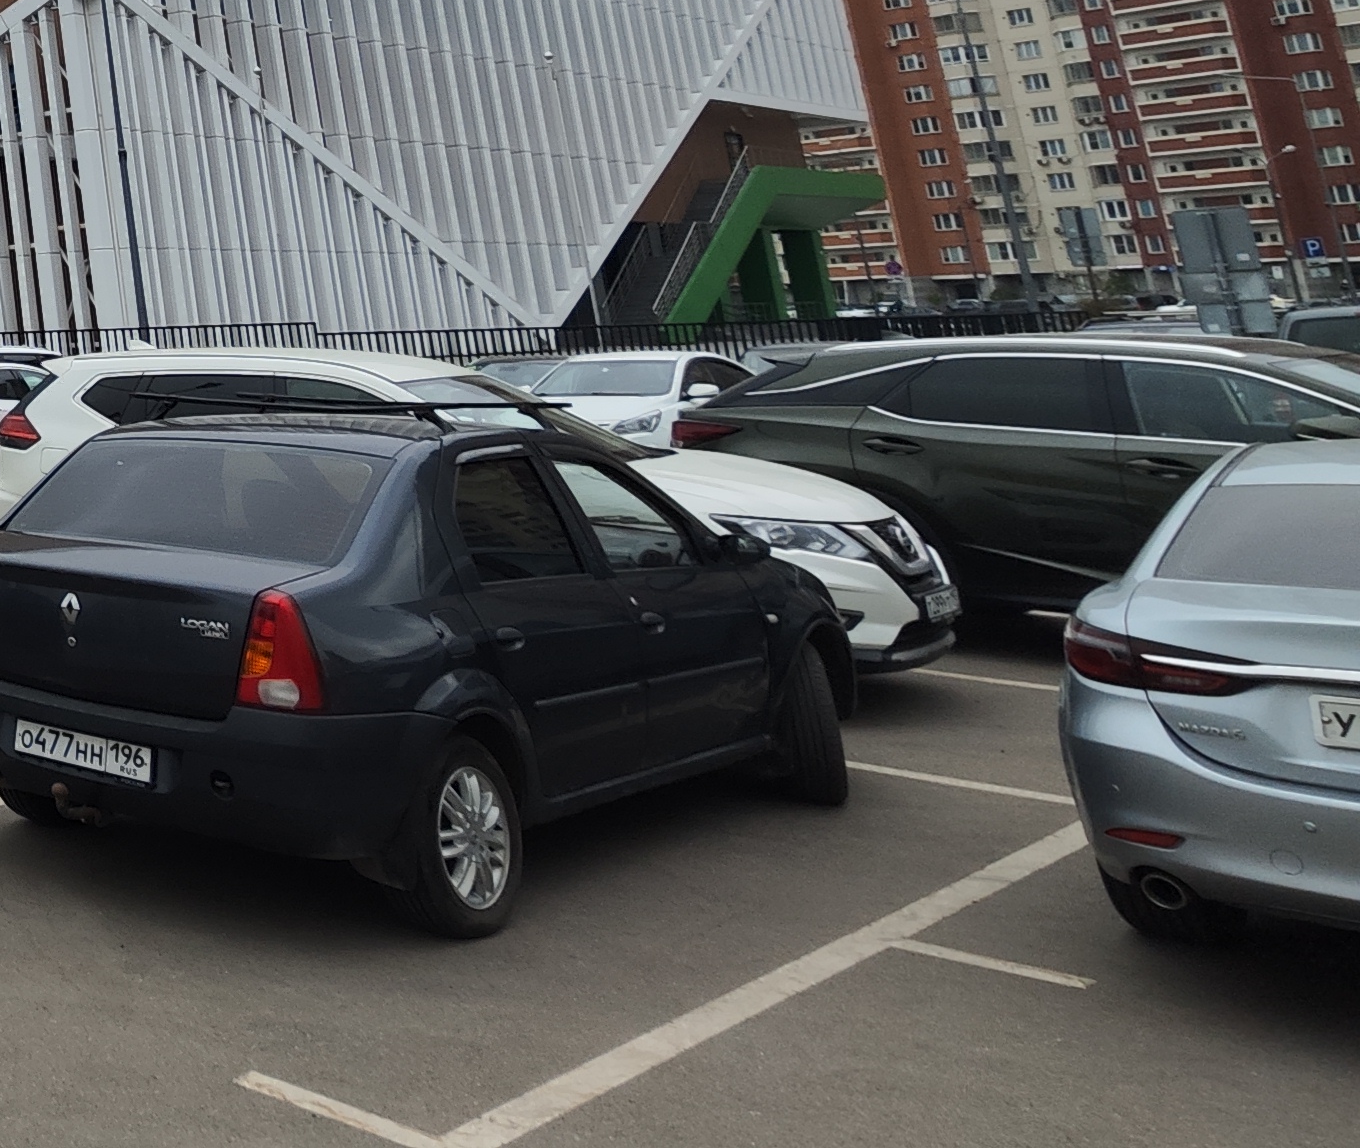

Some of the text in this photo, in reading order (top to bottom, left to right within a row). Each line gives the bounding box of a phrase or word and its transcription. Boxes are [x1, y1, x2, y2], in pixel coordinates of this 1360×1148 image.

[1306, 240, 1320, 256] P
[180, 617, 229, 633] LOGAN
[20, 727, 146, 768] О477НН 196
[120, 765, 138, 777] RUS
